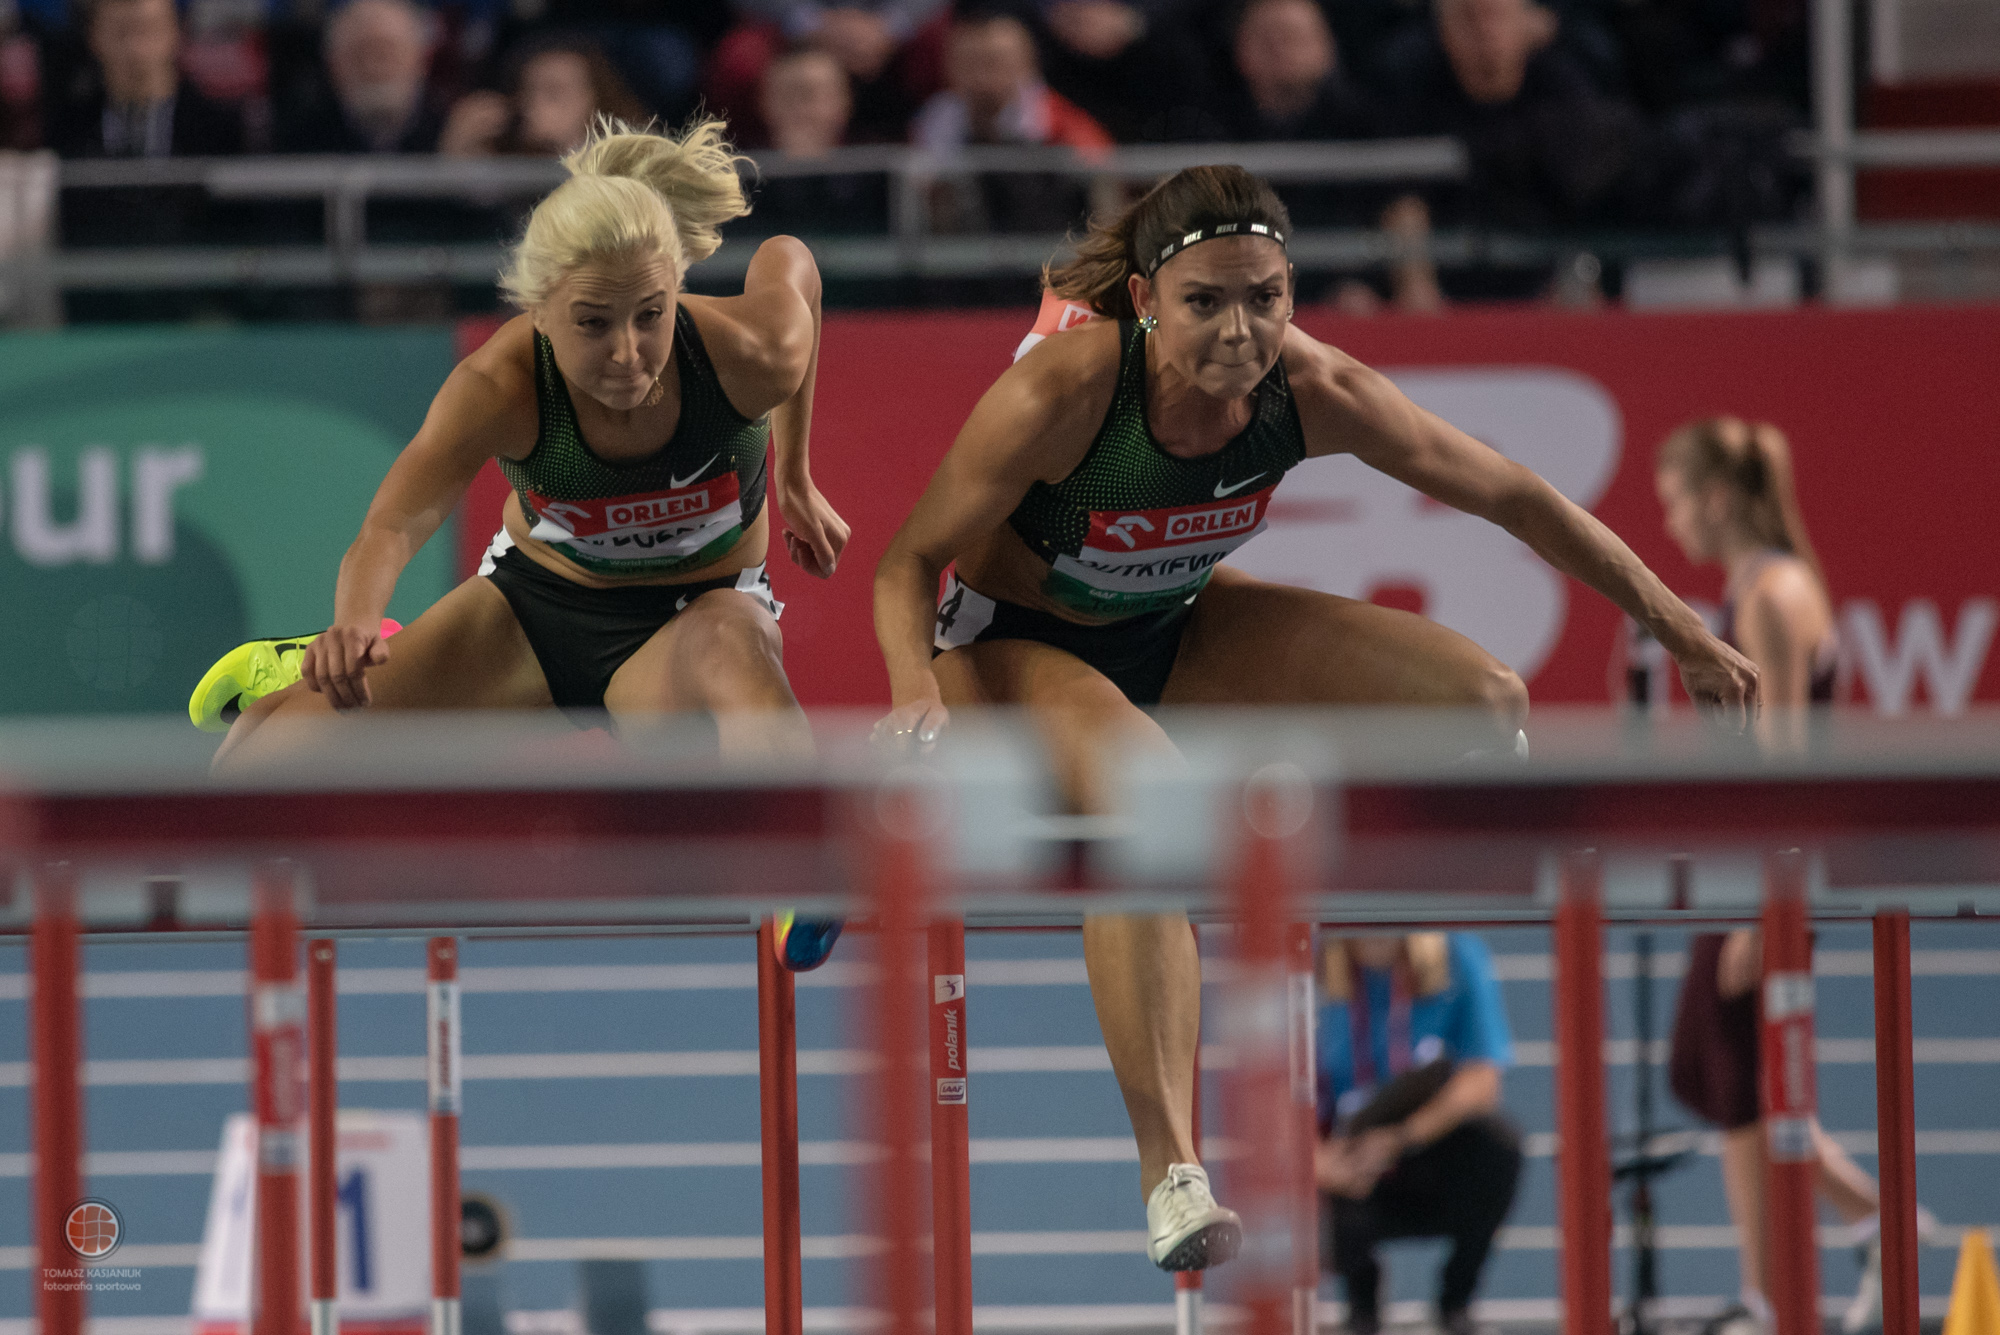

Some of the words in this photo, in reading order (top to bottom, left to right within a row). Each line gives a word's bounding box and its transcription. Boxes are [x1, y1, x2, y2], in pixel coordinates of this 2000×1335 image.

[1182, 229, 1203, 246] NIKE
[1215, 223, 1239, 235] NIKE
[1250, 222, 1268, 234] NIKE
[0, 443, 205, 568] ur
[611, 495, 705, 526] ORLEN
[1170, 505, 1253, 536] ORLEN
[943, 1008, 961, 1070] polanik
